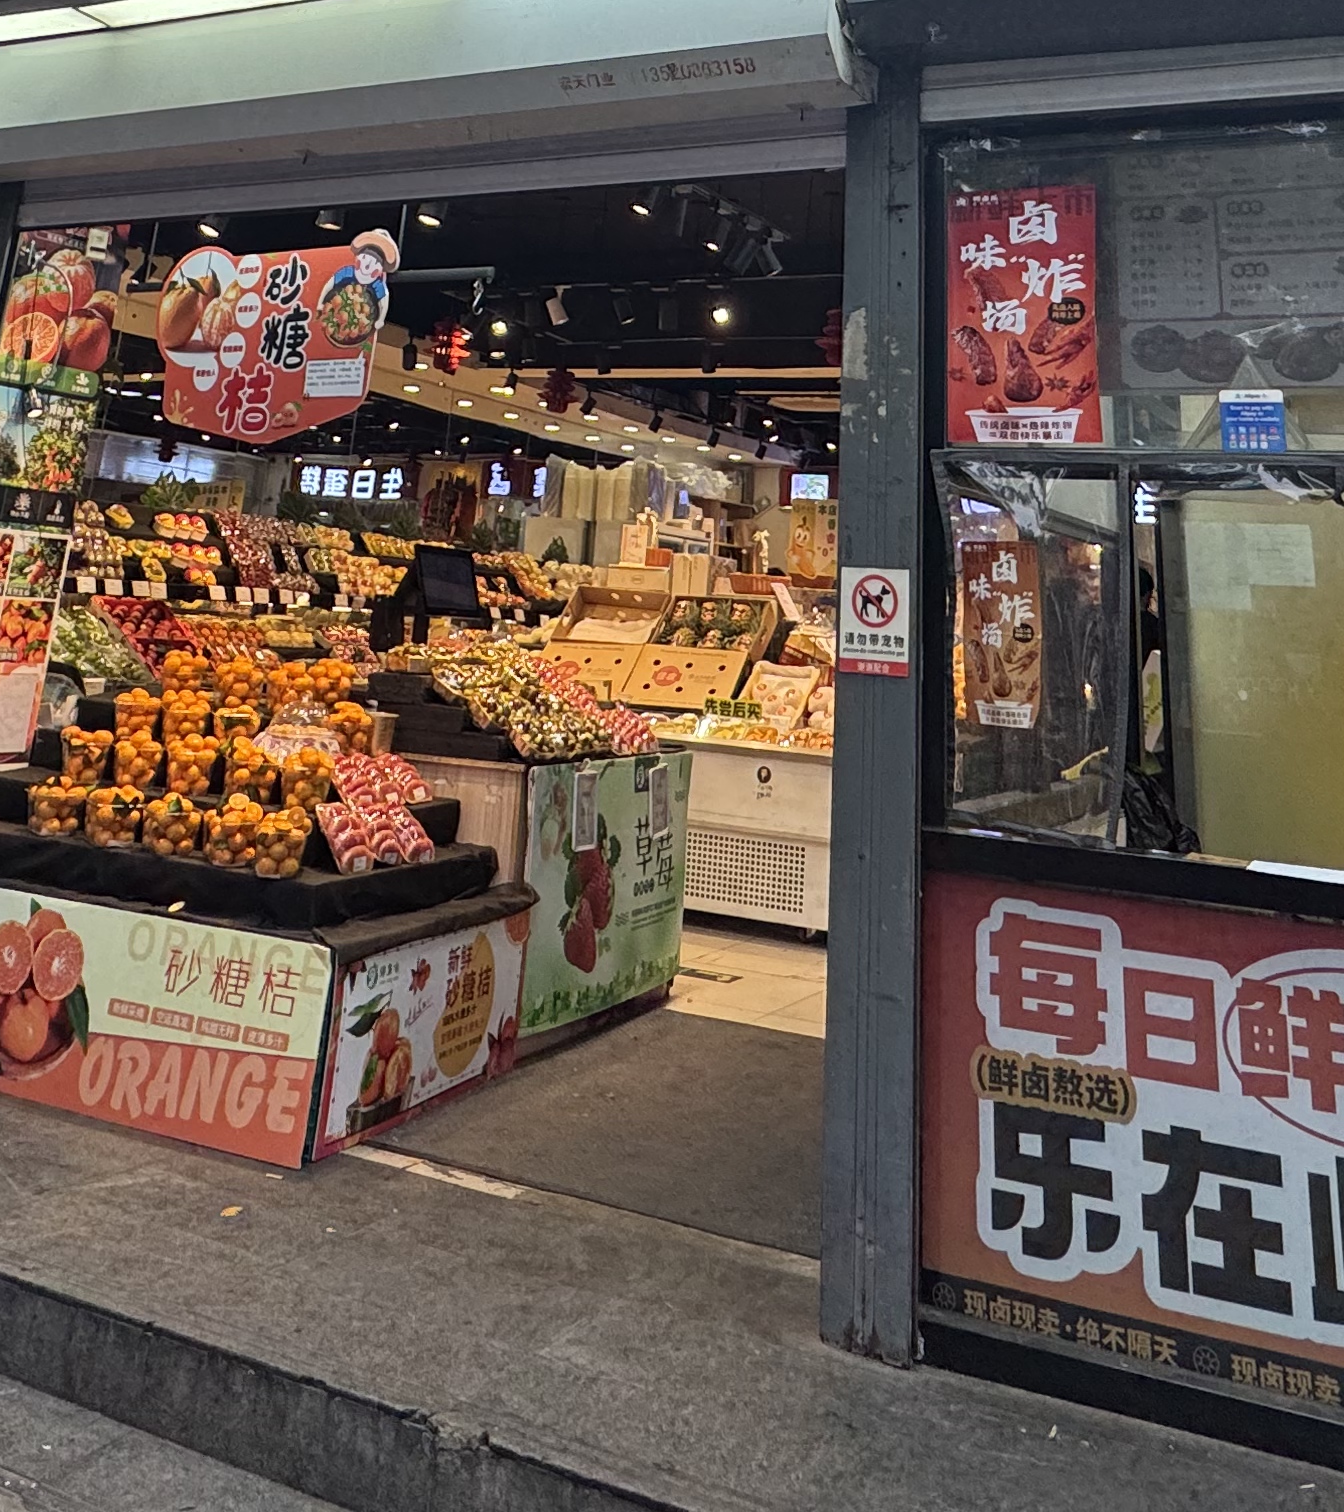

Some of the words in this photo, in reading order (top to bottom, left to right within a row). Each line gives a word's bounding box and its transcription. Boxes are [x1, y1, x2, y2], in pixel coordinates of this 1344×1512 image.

[218, 255, 311, 433] 砂糖桔
[844, 632, 905, 649] 请勿带宠物
[704, 699, 762, 719] 先尝后买
[164, 948, 303, 1018] 砂糖桔
[78, 1037, 308, 1134] ORANGE
